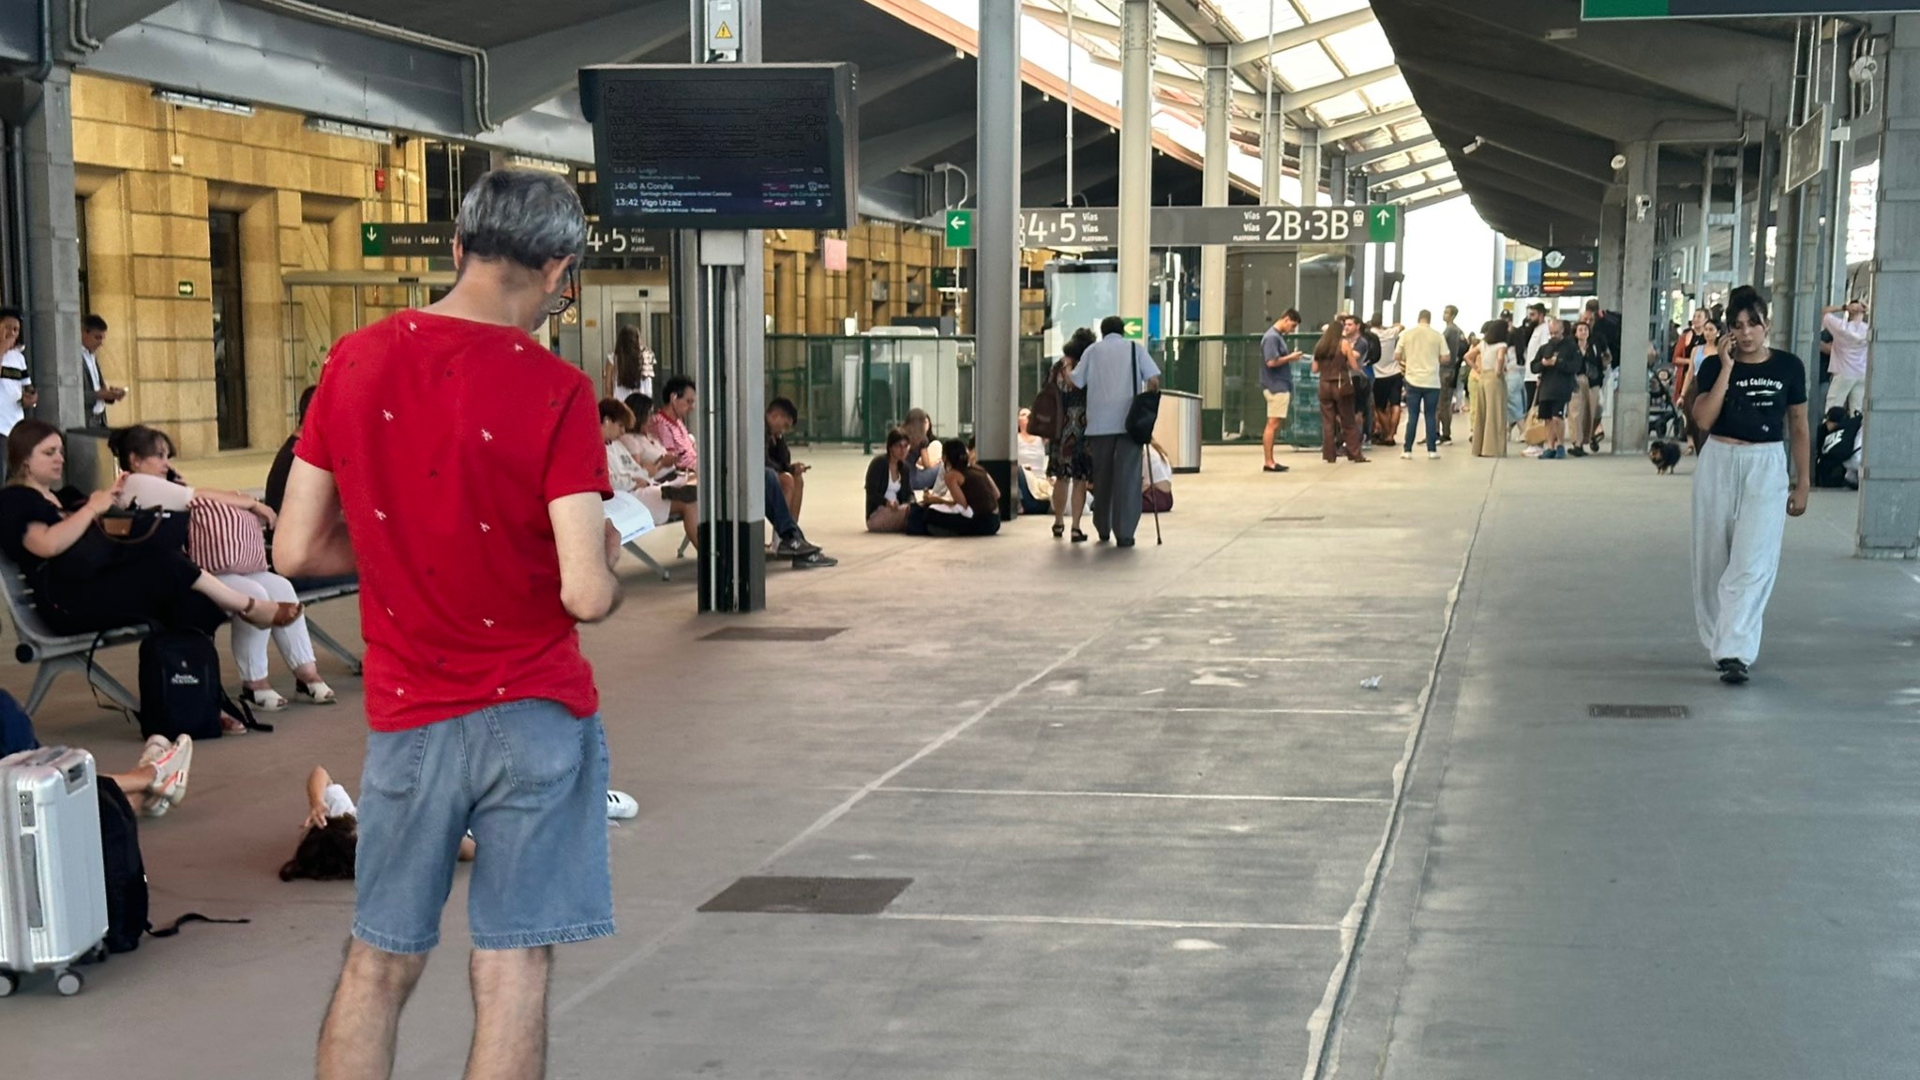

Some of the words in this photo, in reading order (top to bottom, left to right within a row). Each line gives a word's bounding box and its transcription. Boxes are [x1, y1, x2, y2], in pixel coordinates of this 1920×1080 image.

[615, 199, 639, 207] 13:42
[640, 199, 658, 208] Vigo
[816, 199, 823, 207] 3
[1081, 212, 1098, 221] Vías
[1244, 211, 1261, 220] Vías
[1081, 223, 1099, 233] Vías
[1243, 223, 1261, 232] Vías
